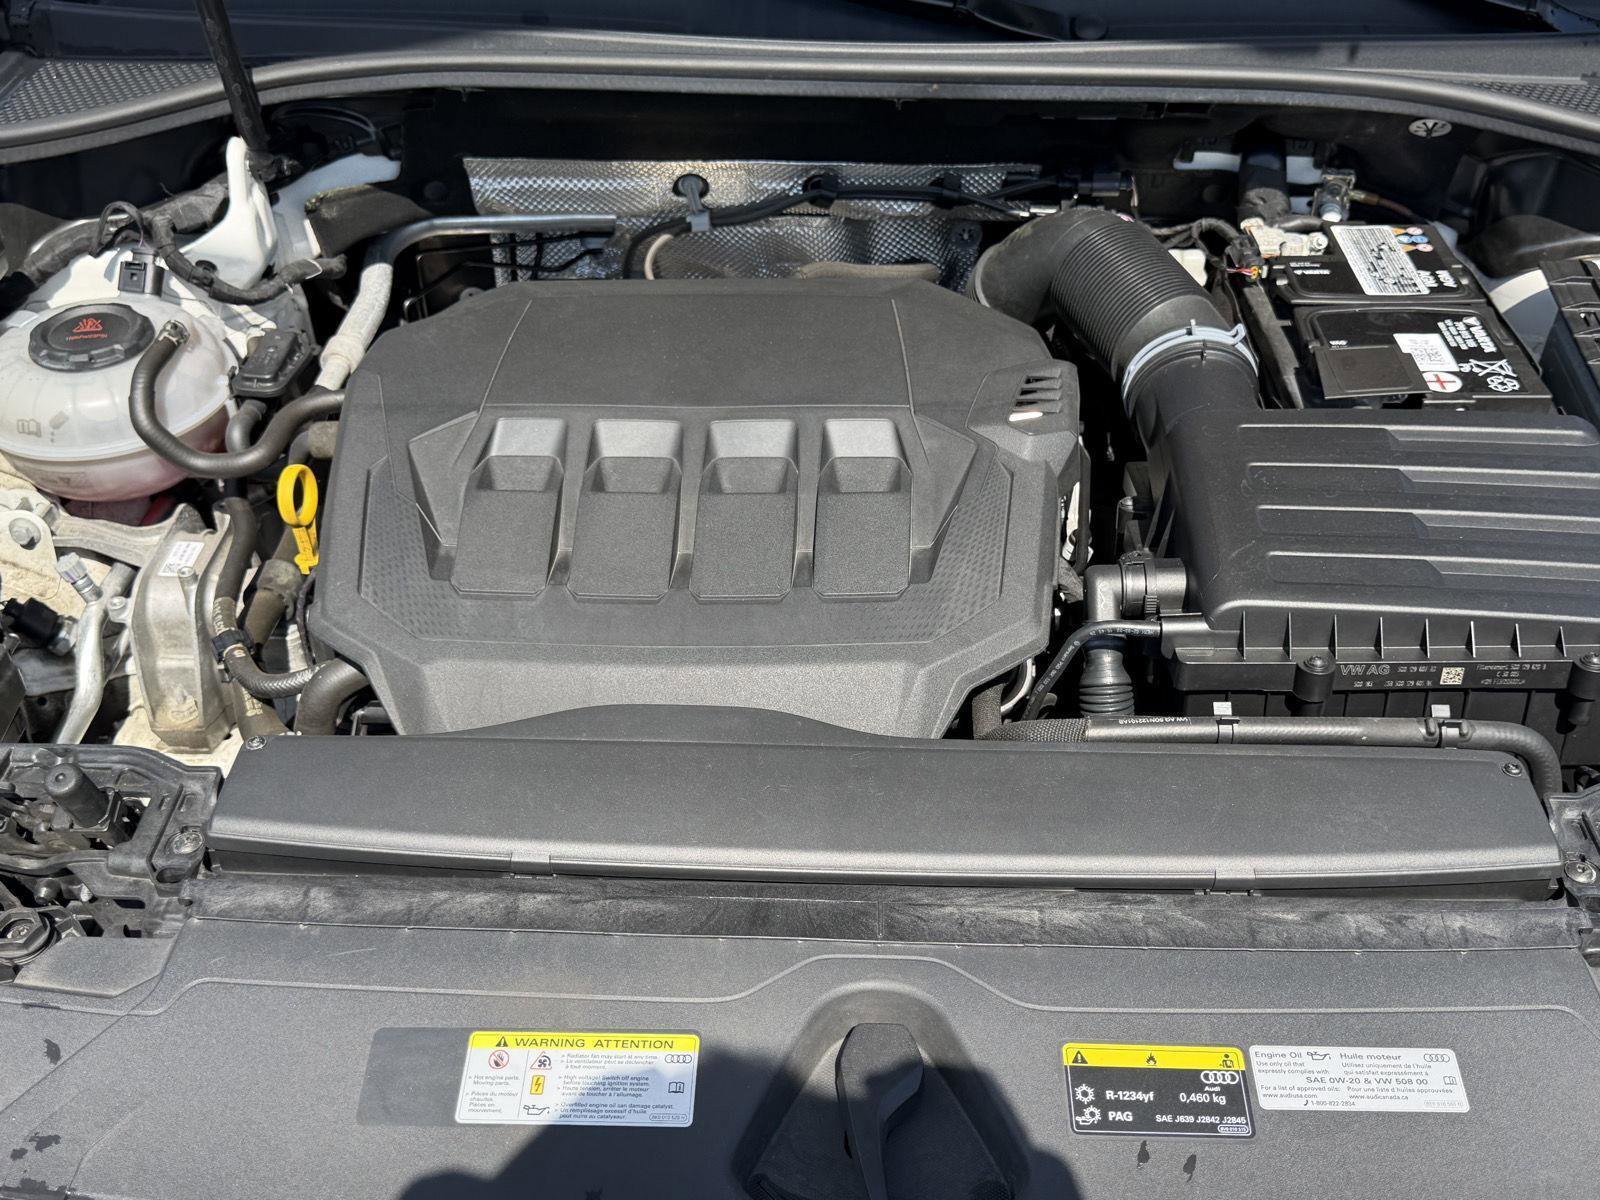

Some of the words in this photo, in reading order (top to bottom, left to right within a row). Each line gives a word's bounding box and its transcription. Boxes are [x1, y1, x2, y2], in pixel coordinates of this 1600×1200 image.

[1340, 664, 1366, 676] VW
[1366, 664, 1390, 676] AG
[515, 1038, 585, 1048] WARNING
[594, 1040, 674, 1049] ATTENTION
[1106, 1090, 1154, 1102] R-1234yf
[1180, 1093, 1210, 1103] 0,460
[1213, 1094, 1226, 1104] kg
[1108, 1112, 1133, 1121] PAG
